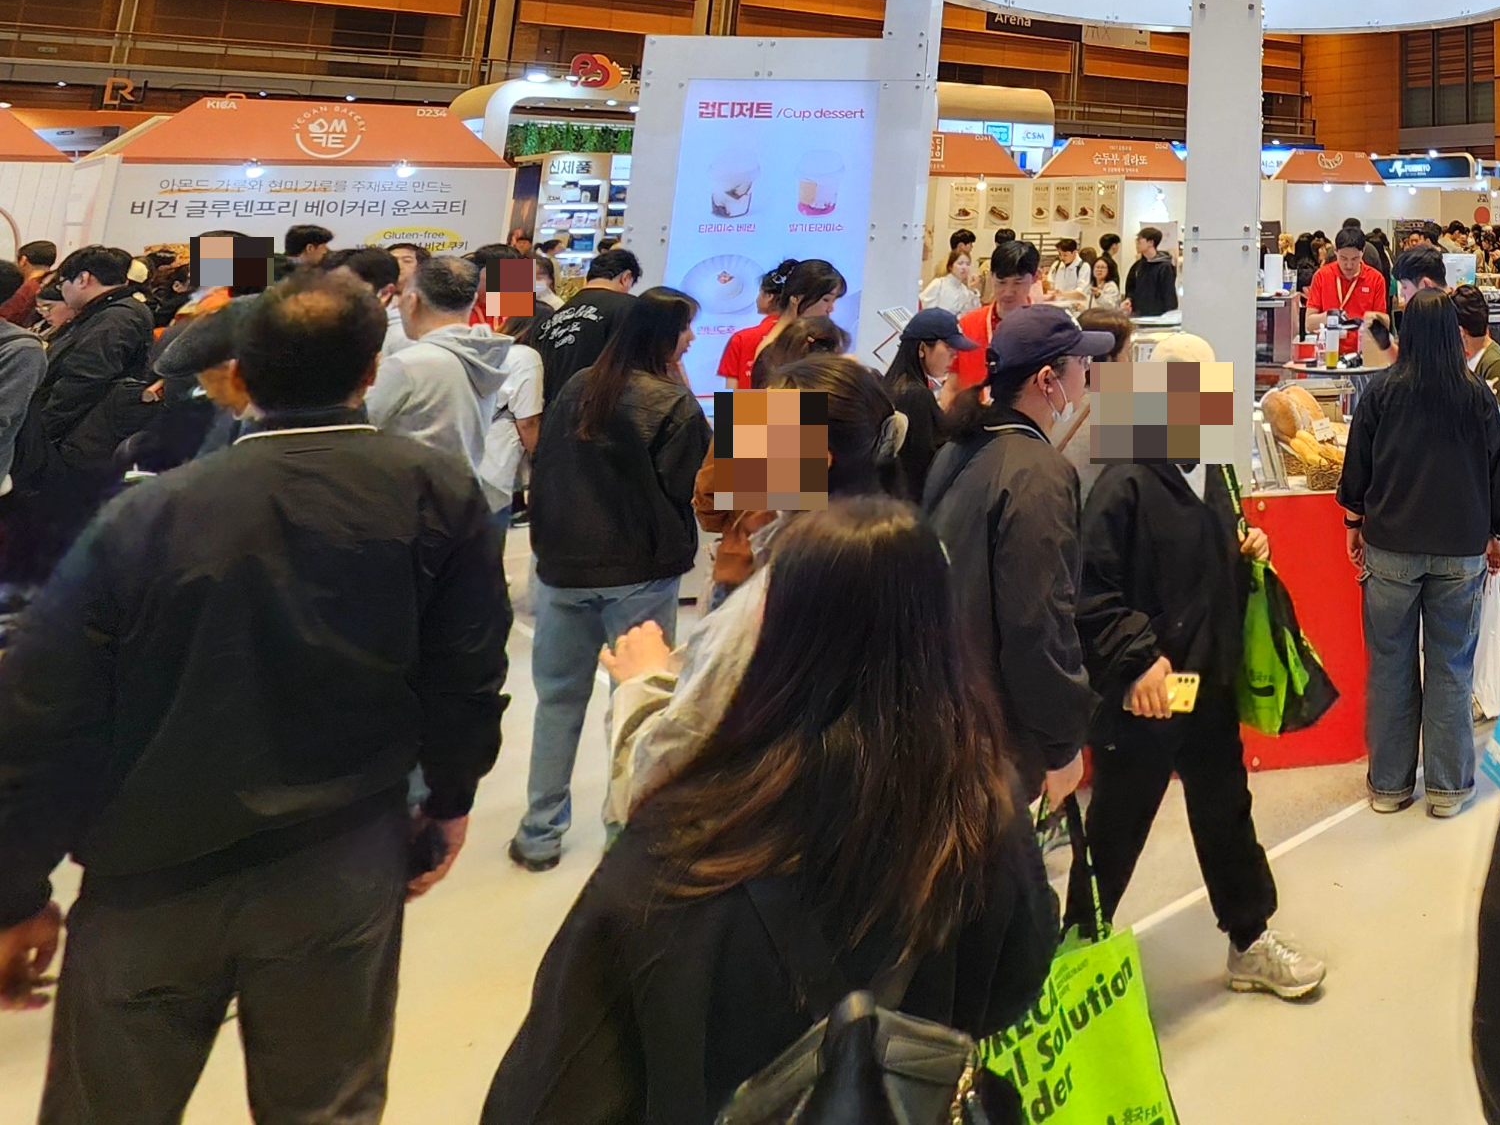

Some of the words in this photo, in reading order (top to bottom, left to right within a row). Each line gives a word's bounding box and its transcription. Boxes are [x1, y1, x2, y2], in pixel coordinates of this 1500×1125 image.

[995, 12, 1032, 28] Arena
[416, 108, 448, 118] D234
[698, 101, 773, 119] 컵디저트
[813, 107, 865, 119] dessert
[292, 105, 328, 131] VEGAN
[333, 105, 367, 132] BAKERY
[1025, 131, 1046, 141] CSM
[1092, 153, 1120, 166] 순두부
[1122, 153, 1149, 166] 젤라또
[549, 160, 593, 175] 신제품
[159, 178, 210, 192] 아몬드
[268, 179, 298, 193] 현미
[352, 180, 409, 193] 주재료로
[412, 180, 452, 194] 만드는
[130, 199, 179, 219] 비건
[185, 199, 299, 219] 글루텐프리
[304, 199, 386, 218] 베이커리
[391, 199, 468, 218] 윤쓰코티
[698, 223, 735, 233] 티라미수
[808, 223, 844, 233] 티라미수
[383, 230, 445, 241] Gluten-free
[447, 241, 469, 251] 쿠키
[1036, 956, 1134, 1073] Solution
